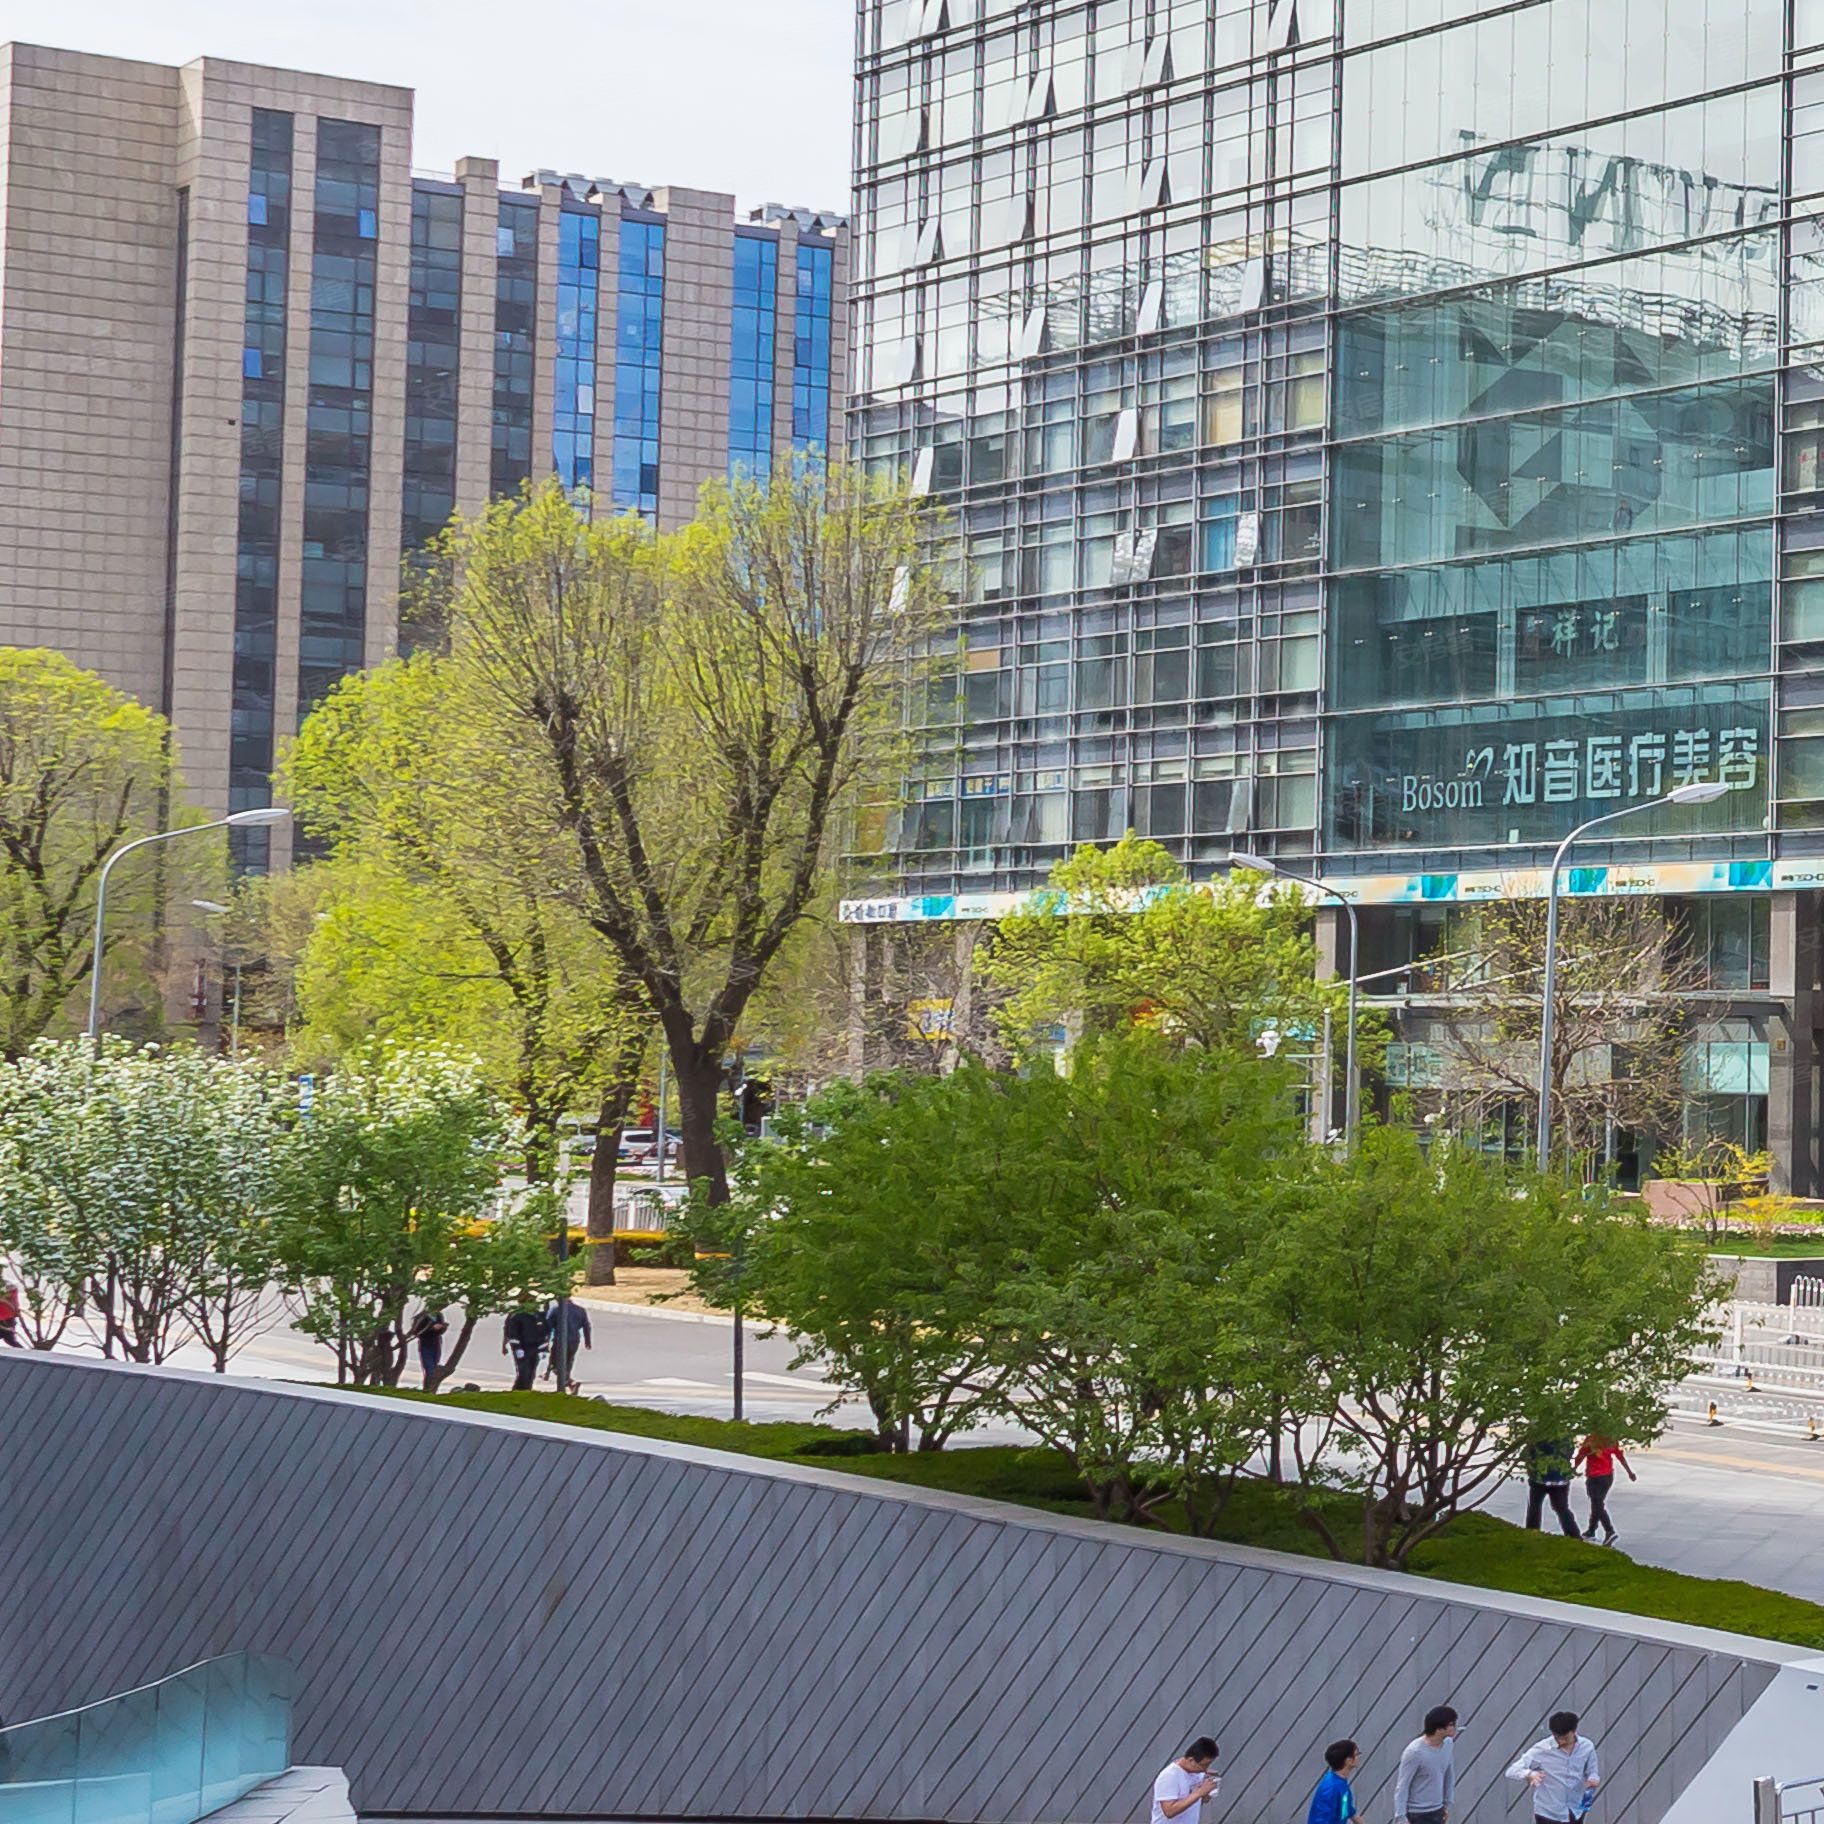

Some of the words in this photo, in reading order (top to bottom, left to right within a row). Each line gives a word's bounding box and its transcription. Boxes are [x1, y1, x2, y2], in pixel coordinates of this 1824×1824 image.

[1402, 775, 1484, 812] Bosom
[1502, 727, 1758, 804] 知音医疗美容
